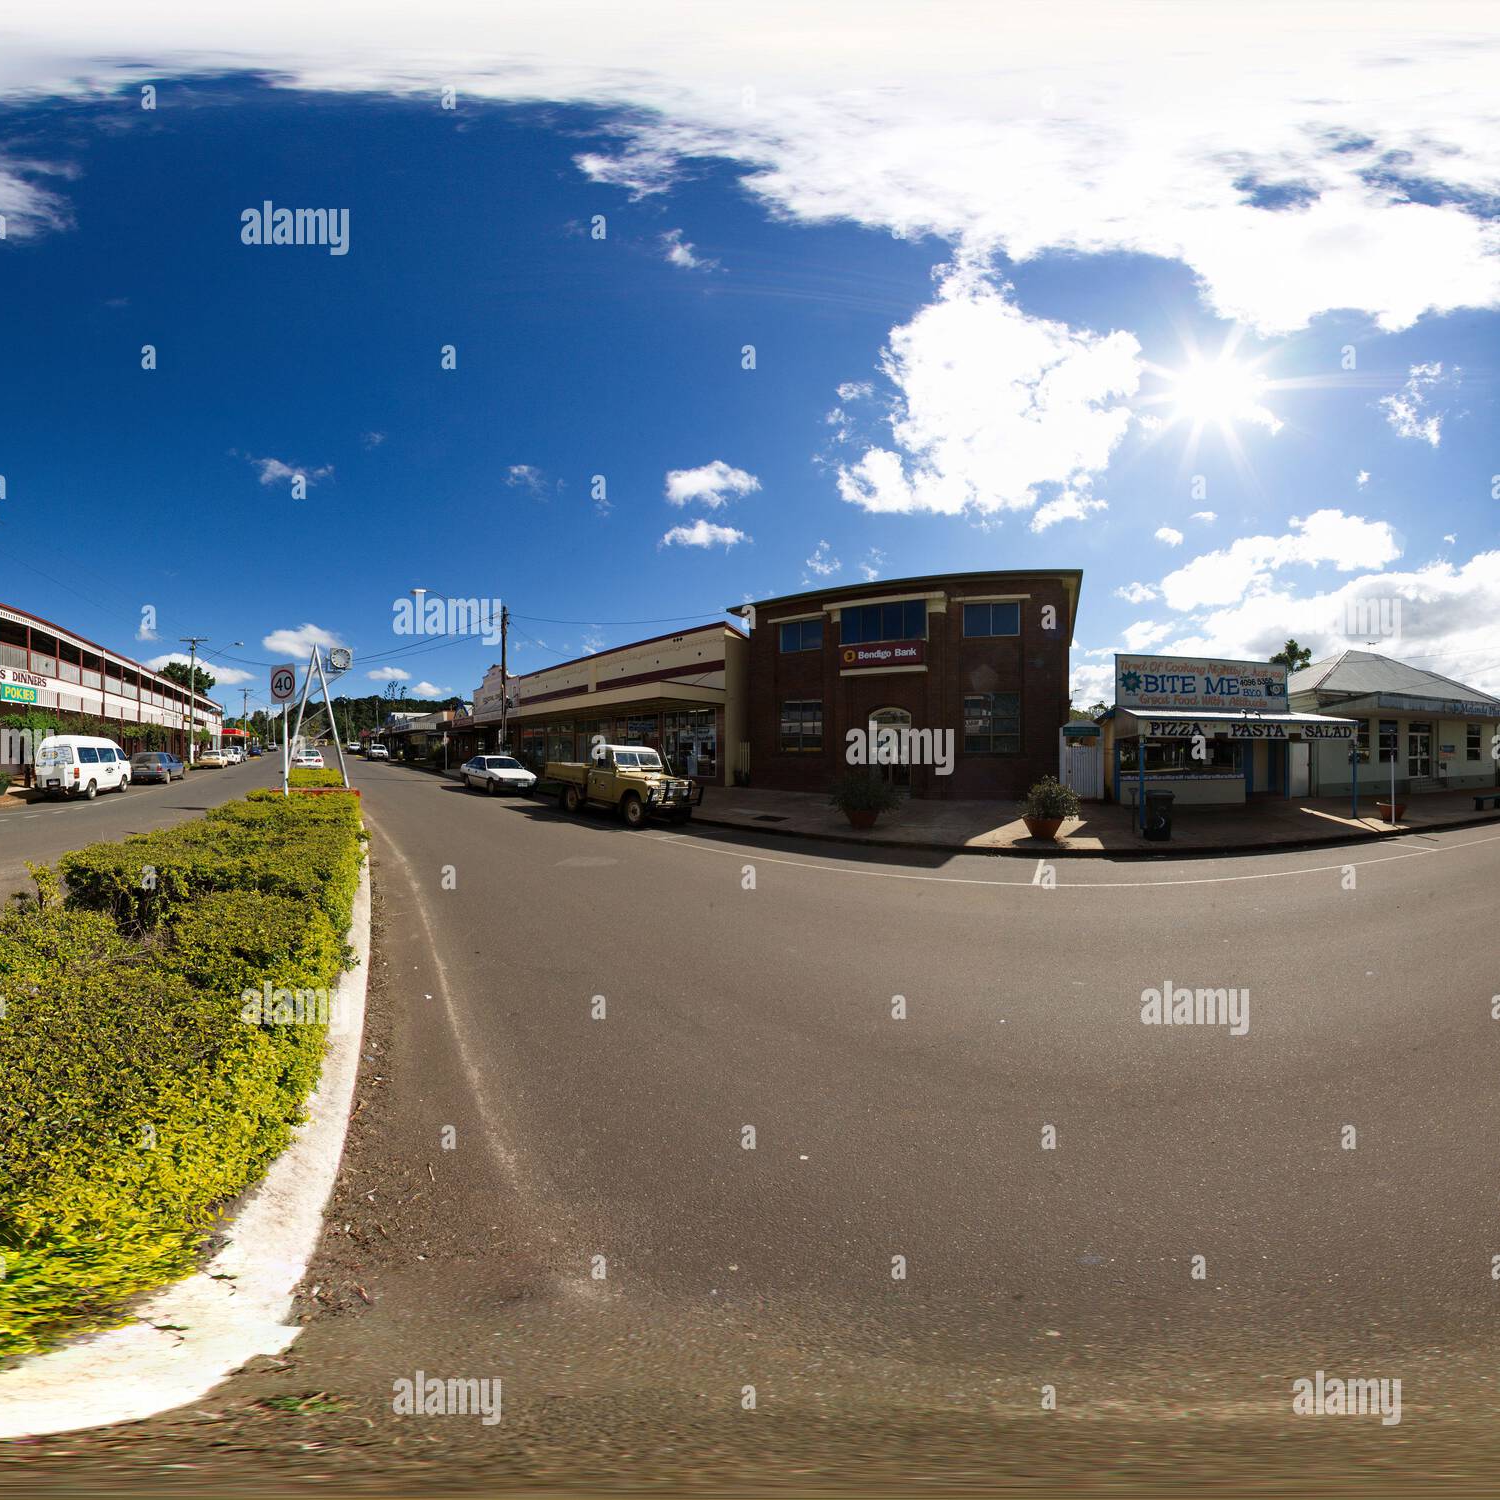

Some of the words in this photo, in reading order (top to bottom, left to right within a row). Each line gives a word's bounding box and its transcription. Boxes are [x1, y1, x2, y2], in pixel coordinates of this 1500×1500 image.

[858, 649, 892, 660] Bendigo
[894, 648, 917, 657] Bank
[1166, 662, 1205, 676] Cooking
[12, 671, 47, 688] DINNERS
[274, 676, 292, 691] 40
[1143, 674, 1196, 694] BITE
[1204, 676, 1239, 695] ME
[4, 685, 35, 701] POKIES
[1139, 694, 1169, 704] Great
[1174, 695, 1197, 705] Food
[1229, 697, 1268, 707] Attitude
[1150, 723, 1205, 737] PIZZA
[1231, 723, 1286, 738] PASTA
[1304, 725, 1351, 738] SALAD
